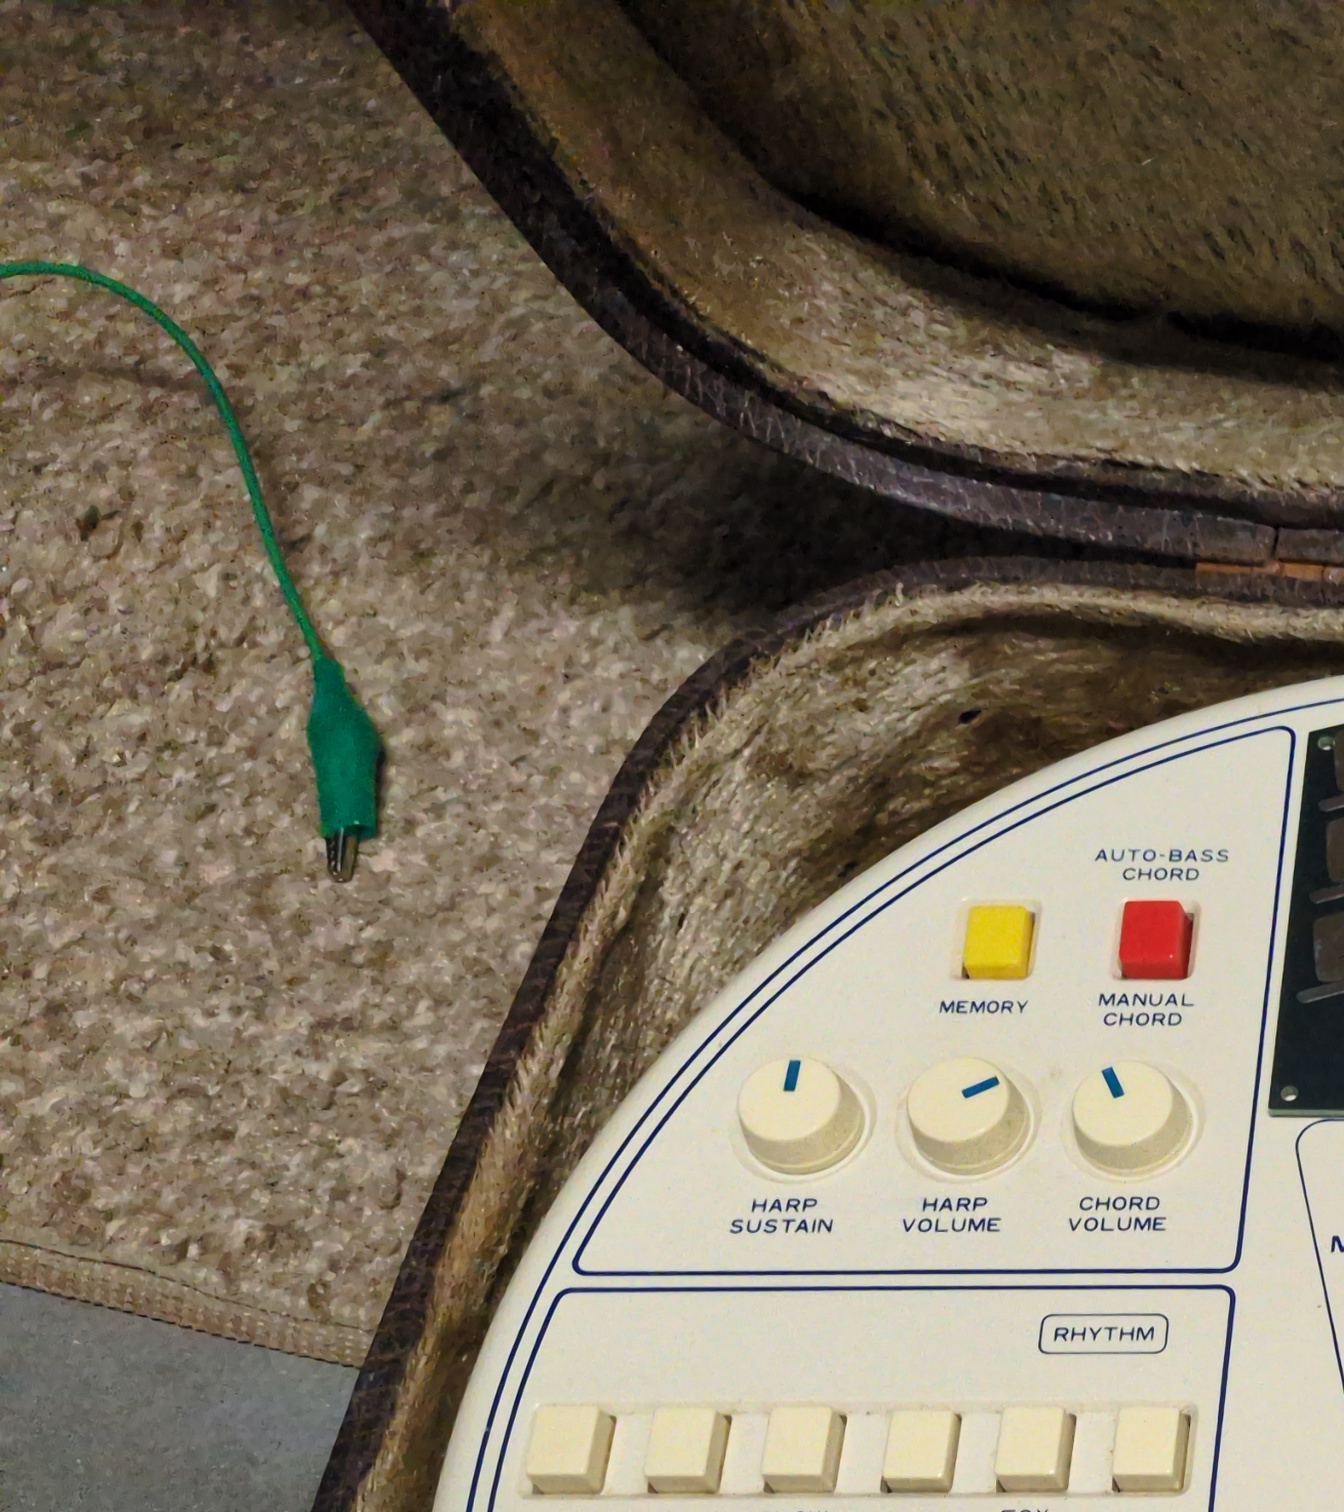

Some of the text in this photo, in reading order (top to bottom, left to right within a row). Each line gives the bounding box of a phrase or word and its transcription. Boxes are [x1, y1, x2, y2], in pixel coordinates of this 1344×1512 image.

[1094, 848, 1229, 863] AUTO-BASS
[1122, 867, 1200, 881] CHORD
[939, 1000, 1028, 1015] MEMORY
[1098, 992, 1194, 1007] MANUAL
[1103, 1012, 1183, 1027] CHORD
[751, 1197, 818, 1213] HARP
[922, 1196, 988, 1212] HARP
[1079, 1196, 1161, 1212] CHORD
[729, 1218, 834, 1235] SUSTAIN
[902, 1217, 1002, 1233] VOLUME
[1068, 1216, 1167, 1232] VOLUME
[1053, 1326, 1155, 1342] RHYTHM
